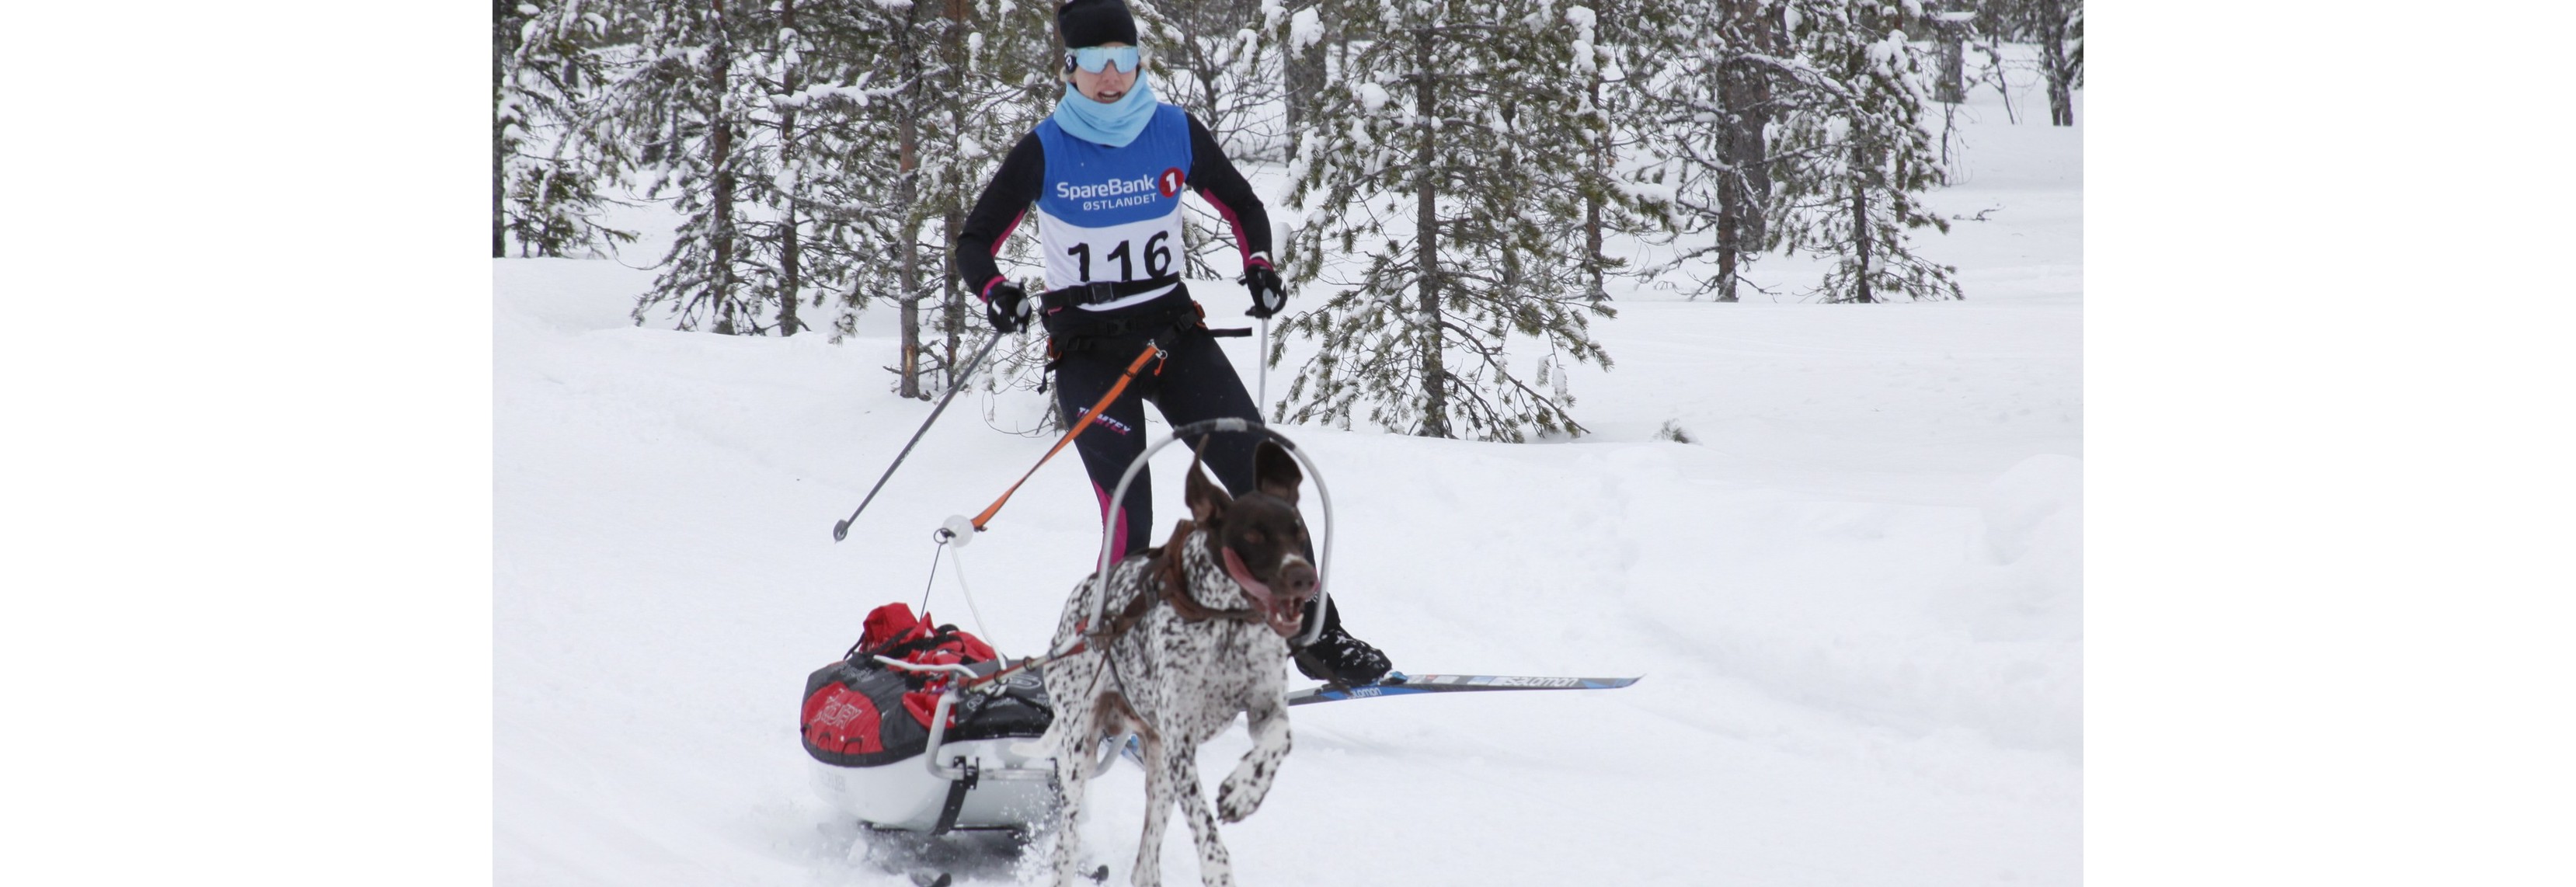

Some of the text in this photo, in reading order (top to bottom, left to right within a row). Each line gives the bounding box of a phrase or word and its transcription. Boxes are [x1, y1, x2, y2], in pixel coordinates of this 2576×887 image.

[1057, 174, 1156, 201] SpareBank
[1083, 193, 1157, 211] ØSTLANDET
[1067, 230, 1171, 283] 116
[1077, 406, 1131, 435] TMTEX
